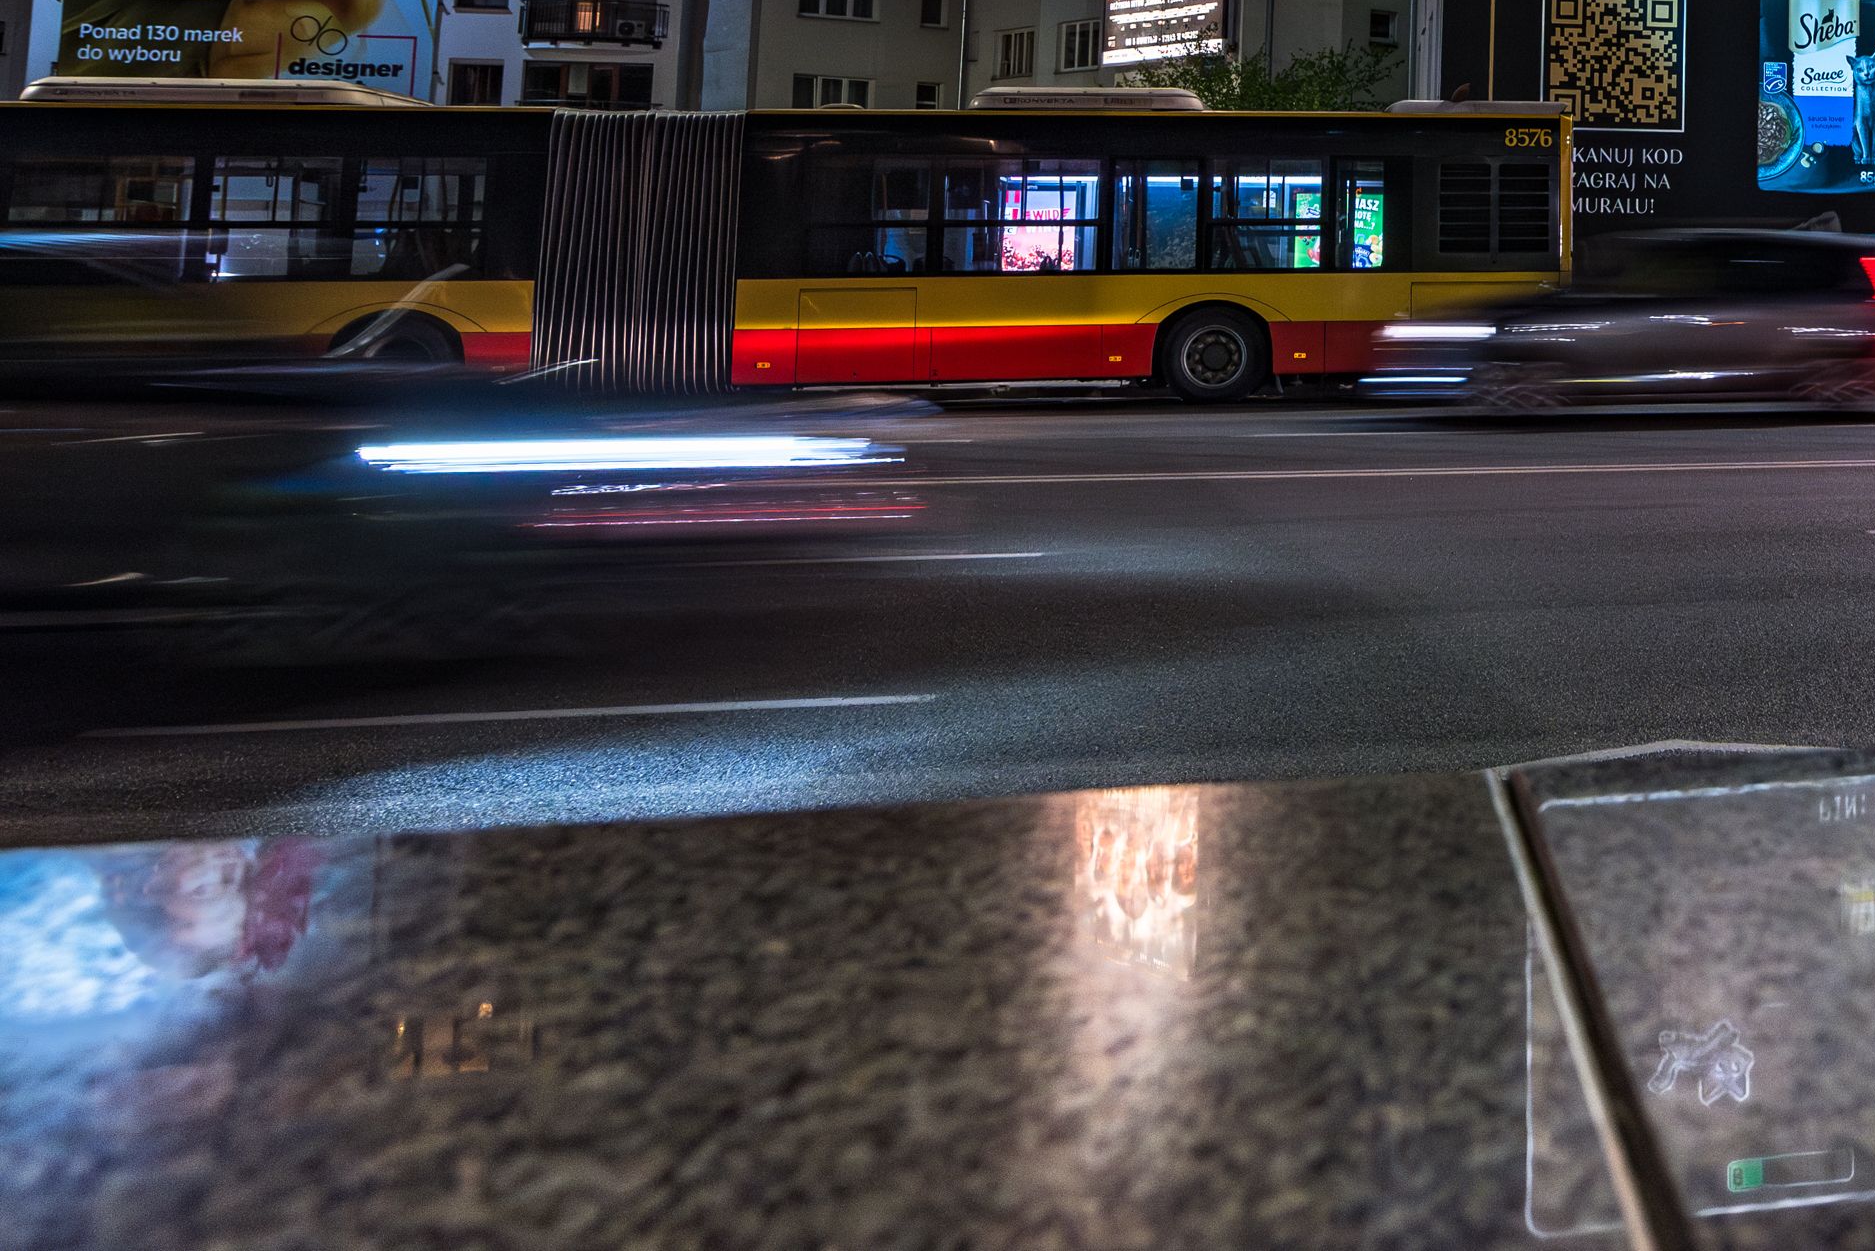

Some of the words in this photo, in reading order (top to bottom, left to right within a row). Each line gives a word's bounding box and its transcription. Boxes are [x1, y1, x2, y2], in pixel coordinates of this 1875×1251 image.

[79, 22, 140, 41] Ponad
[146, 24, 179, 42] 130
[184, 26, 243, 44] marek
[77, 44, 103, 61] do
[108, 46, 182, 65] wyboru
[288, 57, 404, 79] designer
[1800, 67, 1844, 85] Sauce
[1504, 128, 1553, 148] 8576
[1572, 147, 1634, 167] KANUJ
[1642, 148, 1683, 165] KOD
[1644, 173, 1671, 190] NA
[1032, 209, 1060, 221] WILD
